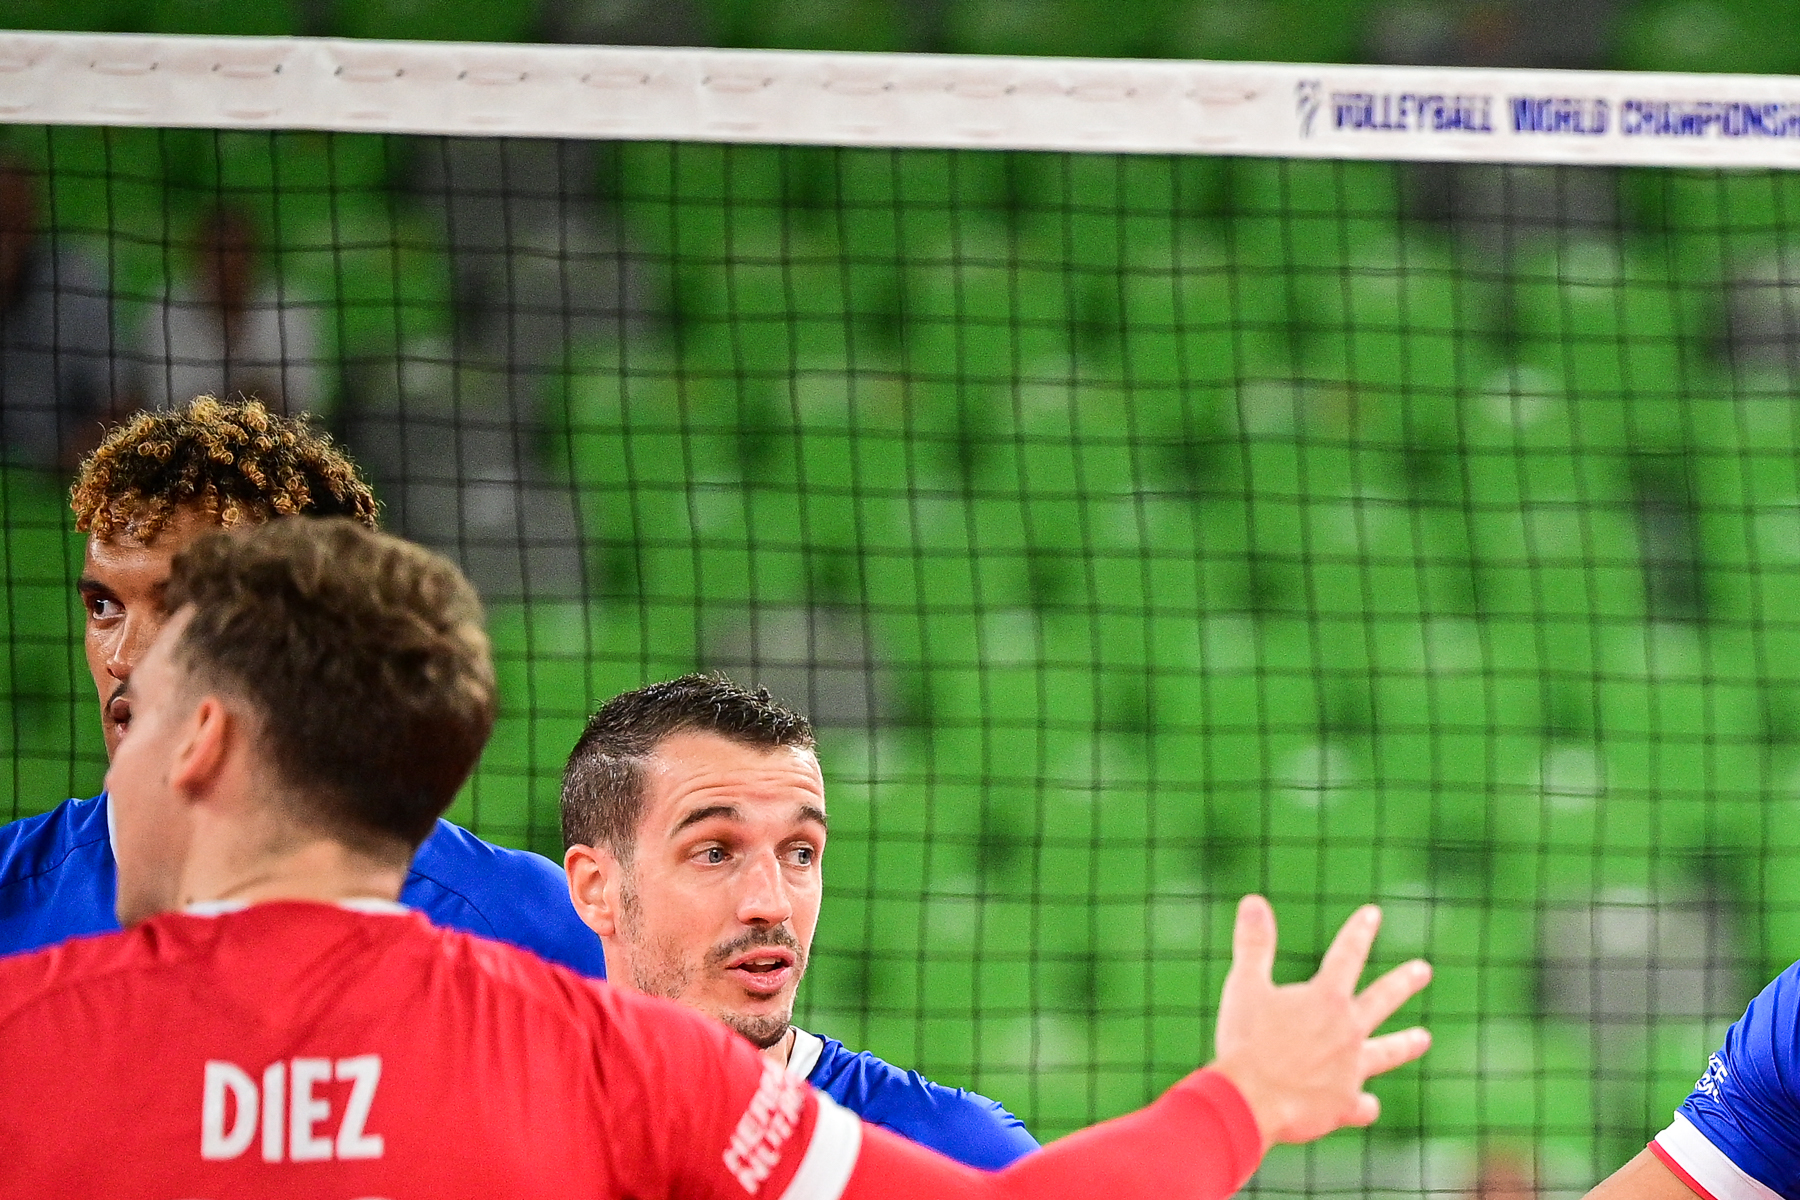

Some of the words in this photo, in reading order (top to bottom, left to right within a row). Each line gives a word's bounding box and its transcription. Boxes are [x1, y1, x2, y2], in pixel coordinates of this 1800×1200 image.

[1333, 93, 1494, 133] VOLLEYBALL
[1510, 97, 1611, 136] WORLD
[201, 1055, 384, 1161] DIEZ
